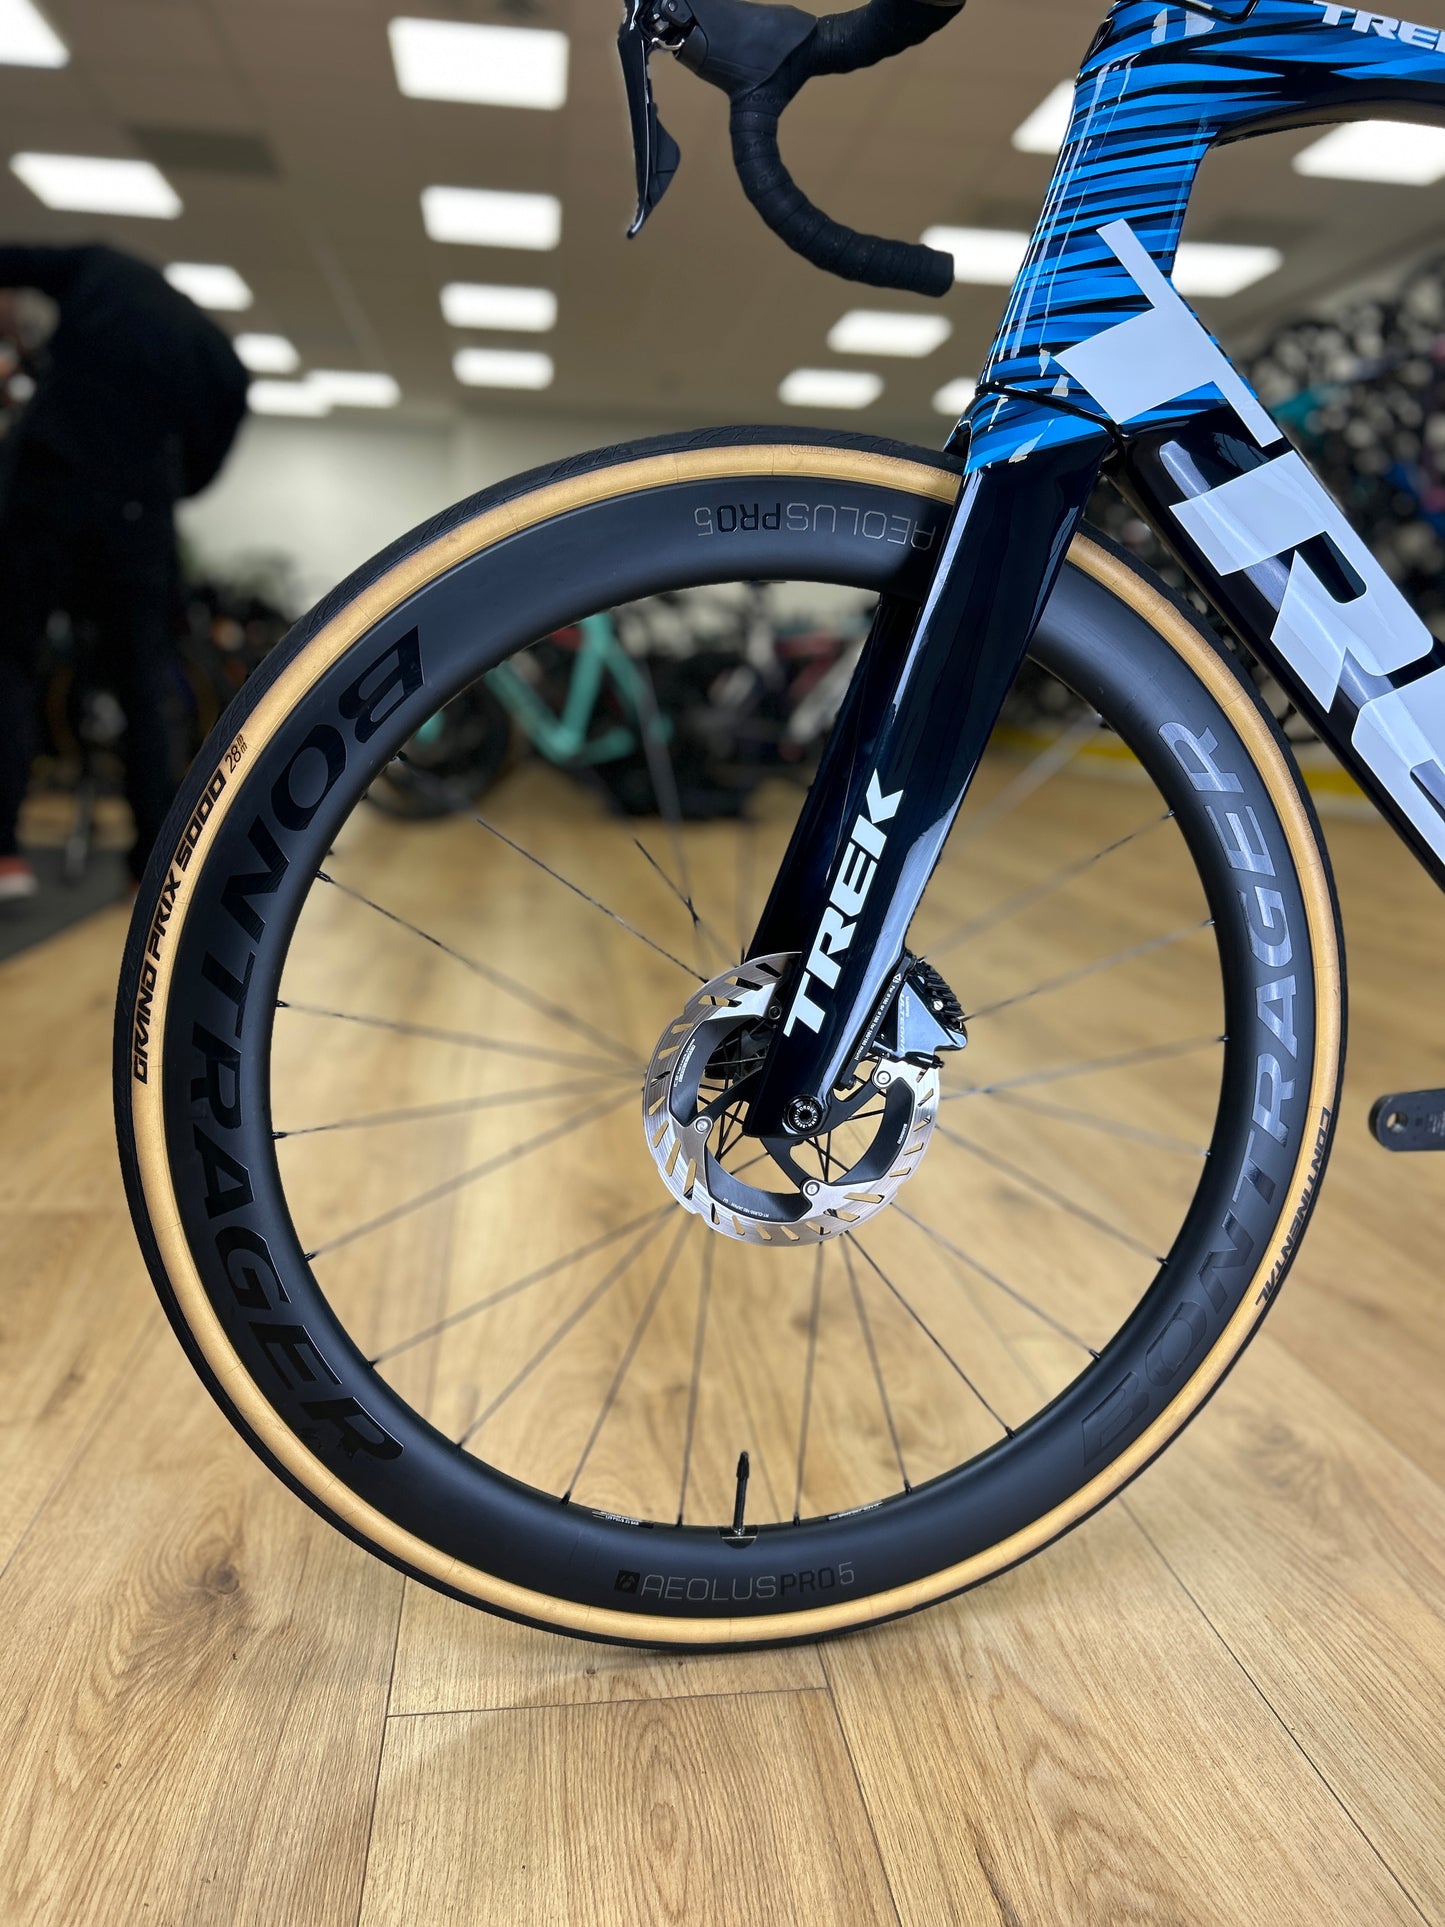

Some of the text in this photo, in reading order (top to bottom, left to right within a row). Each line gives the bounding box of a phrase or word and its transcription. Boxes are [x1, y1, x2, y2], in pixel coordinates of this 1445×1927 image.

[1313, 0, 1445, 53] TRE
[133, 966, 157, 1084] GRAND
[147, 868, 181, 961] PRIX
[175, 768, 227, 872] 5000
[189, 625, 425, 1464] BONTRAGER
[783, 768, 904, 1037] TREK
[1082, 721, 1297, 1466] BONTRAGER
[1255, 1106, 1331, 1306] CONTINENTAL
